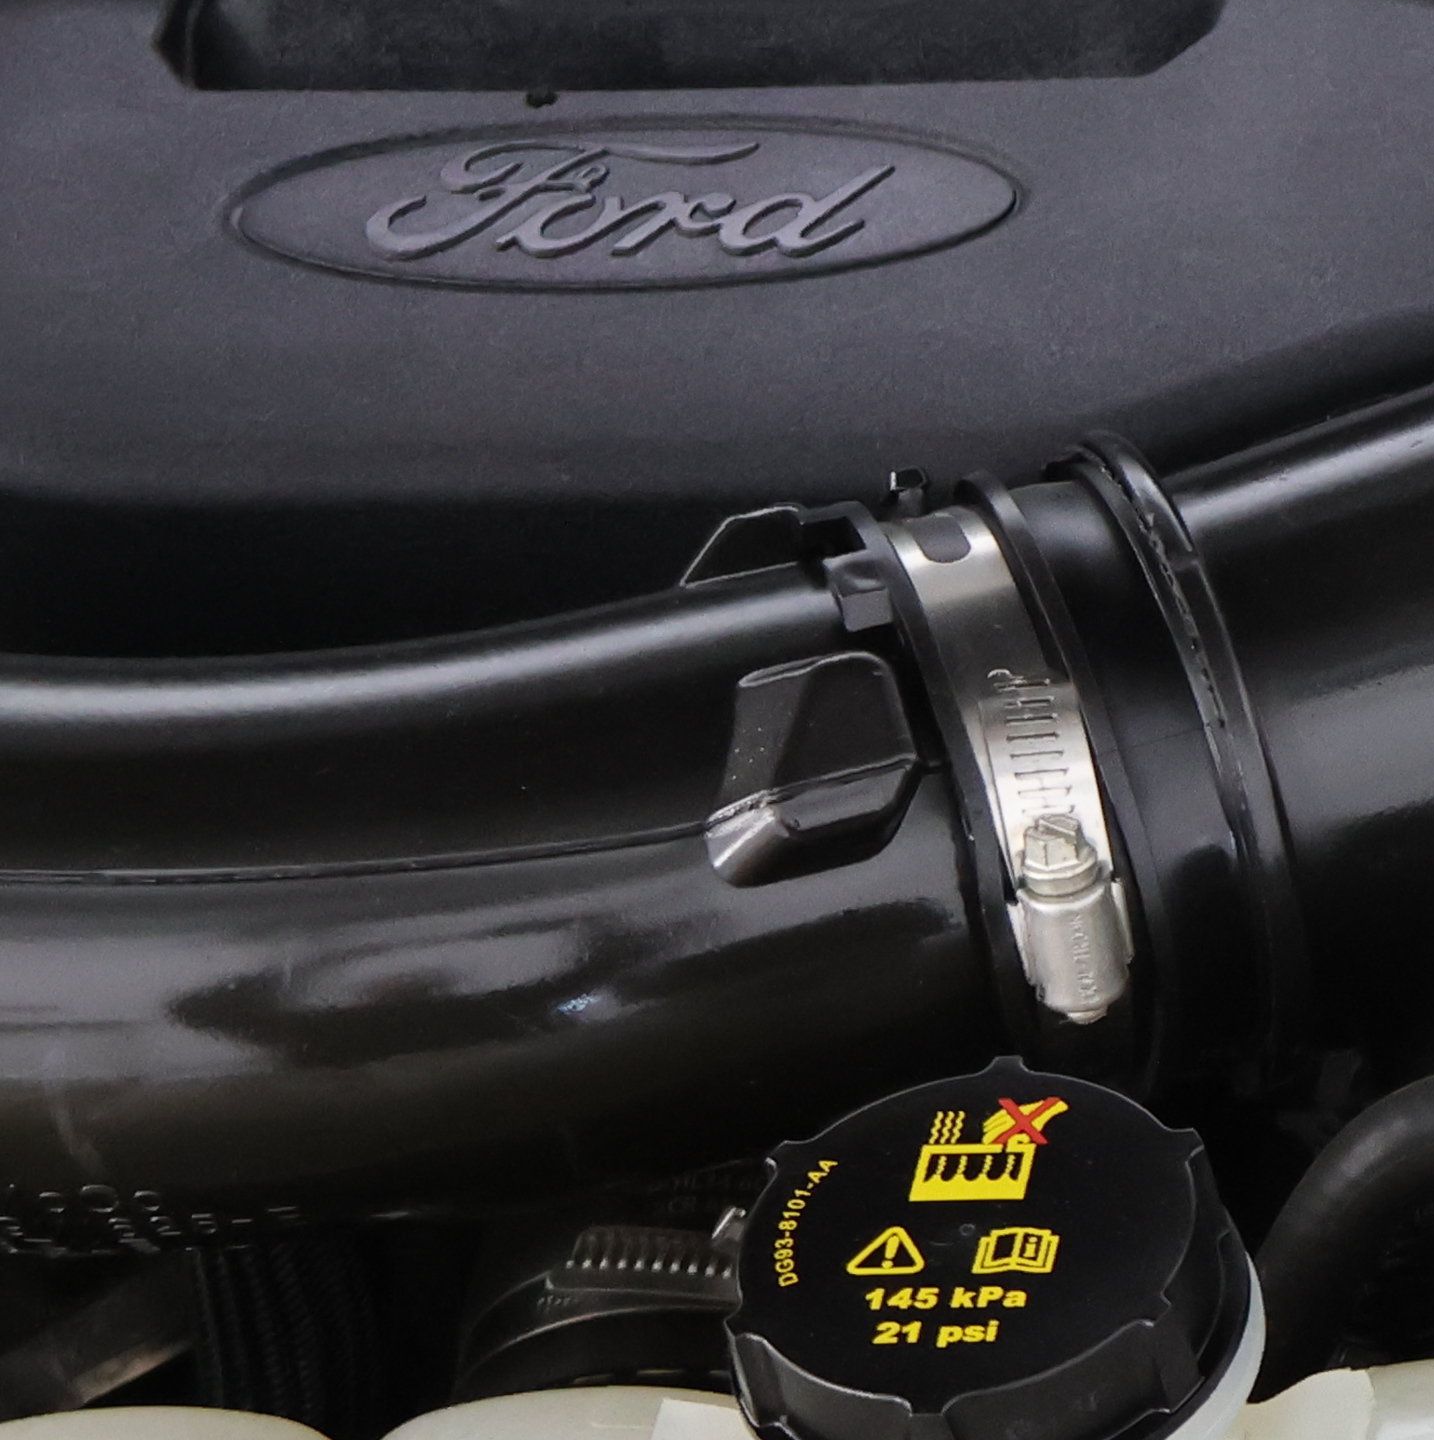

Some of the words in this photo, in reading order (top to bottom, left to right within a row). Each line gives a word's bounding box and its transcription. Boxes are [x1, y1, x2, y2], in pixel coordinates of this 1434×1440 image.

[366, 140, 896, 261] Ford
[774, 1159, 838, 1287] DG93-8101-AA
[865, 1286, 941, 1311] 145
[949, 1285, 1028, 1309] kPa
[872, 1320, 923, 1345] 21
[935, 1319, 1000, 1349] psi
